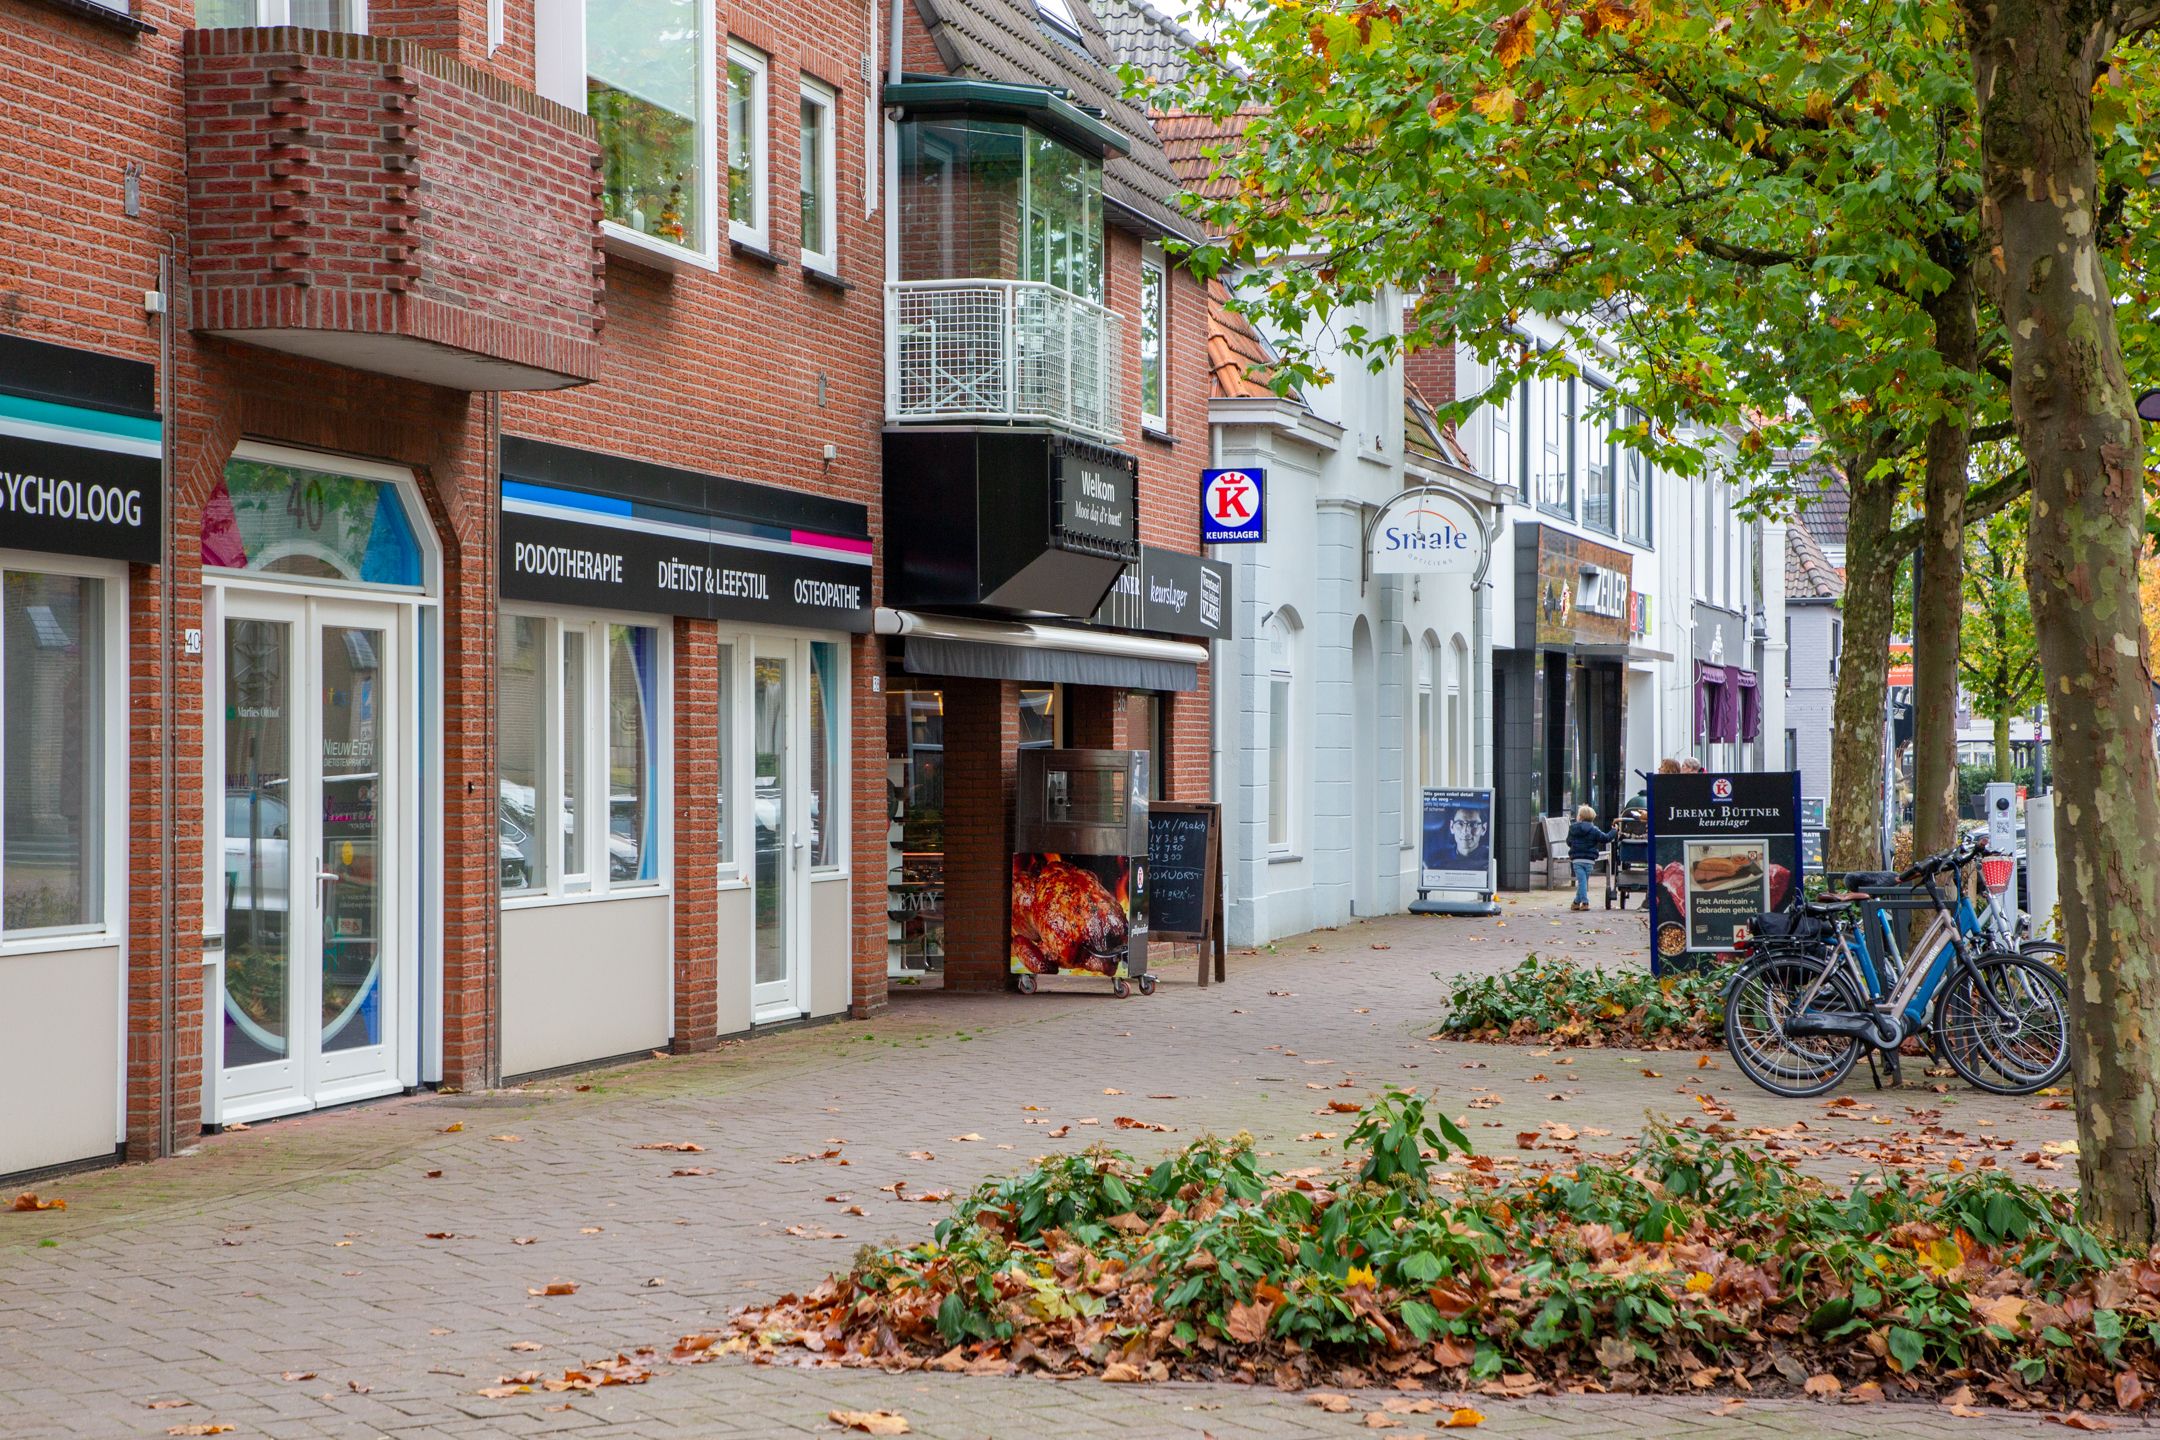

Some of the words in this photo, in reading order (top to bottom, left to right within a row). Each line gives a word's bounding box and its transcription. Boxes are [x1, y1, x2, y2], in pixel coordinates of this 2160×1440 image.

[1081, 470, 1114, 502] Welkom
[287, 478, 323, 531] 40
[1075, 500, 1090, 519] Mooi
[1215, 486, 1250, 518] K
[1206, 530, 1259, 540] KEURSLAGER
[1386, 525, 1467, 550] Smale
[515, 542, 623, 583] PODOTHERAPIE
[658, 557, 704, 593] DIËTIST
[705, 569, 714, 594] &
[716, 569, 769, 600] LEEFSTIJL
[1111, 574, 1140, 595] TNER
[794, 578, 860, 610] OSTEOPATHIE
[1150, 576, 1188, 613] keurslager
[1202, 600, 1219, 622] VLEES
[187, 632, 199, 649] 40
[1716, 784, 1728, 794] K
[1669, 806, 1716, 820] JEREMY
[1721, 805, 1780, 817] BÜTTNER
[1699, 817, 1750, 828] keurslager
[890, 892, 938, 911] EMY
[1696, 897, 1711, 905] Filet
[1712, 897, 1748, 905] Americain
[1696, 906, 1731, 914] Gebraden
[1732, 906, 1758, 915] gehakt
